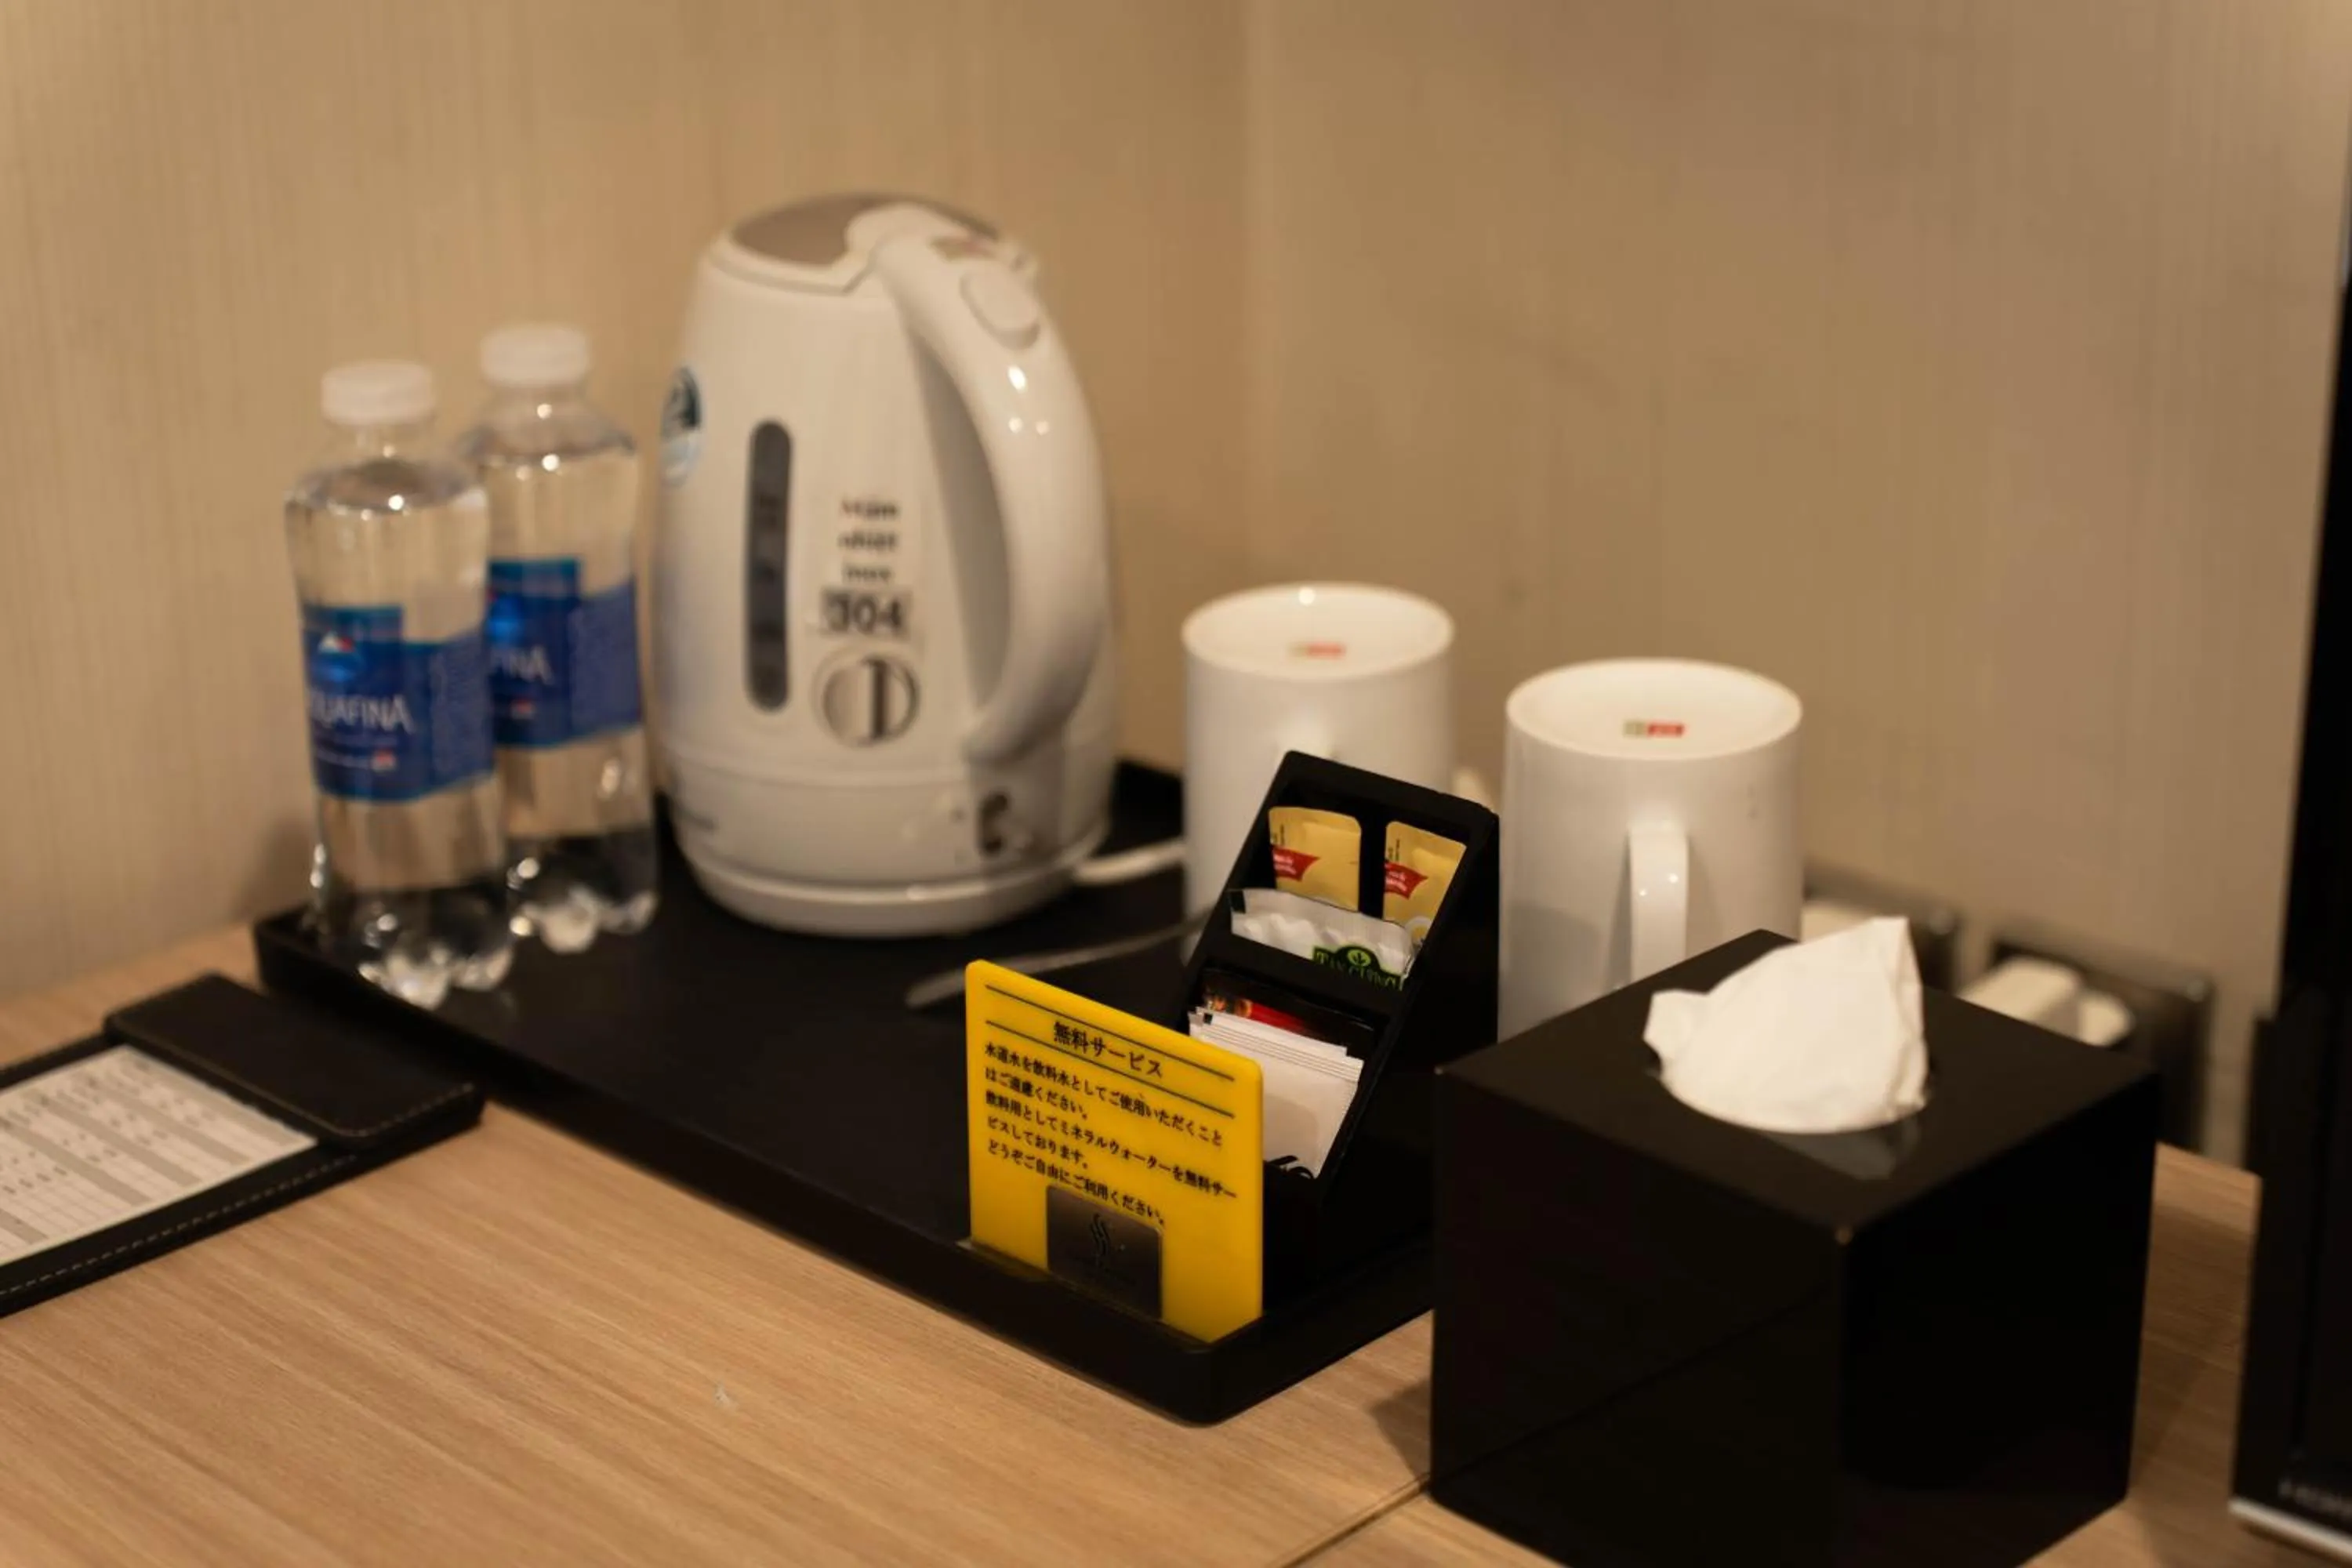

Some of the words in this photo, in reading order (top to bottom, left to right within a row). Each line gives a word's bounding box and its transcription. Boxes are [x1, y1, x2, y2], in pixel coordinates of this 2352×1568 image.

[1053, 1021, 1163, 1078] 無料サービス
